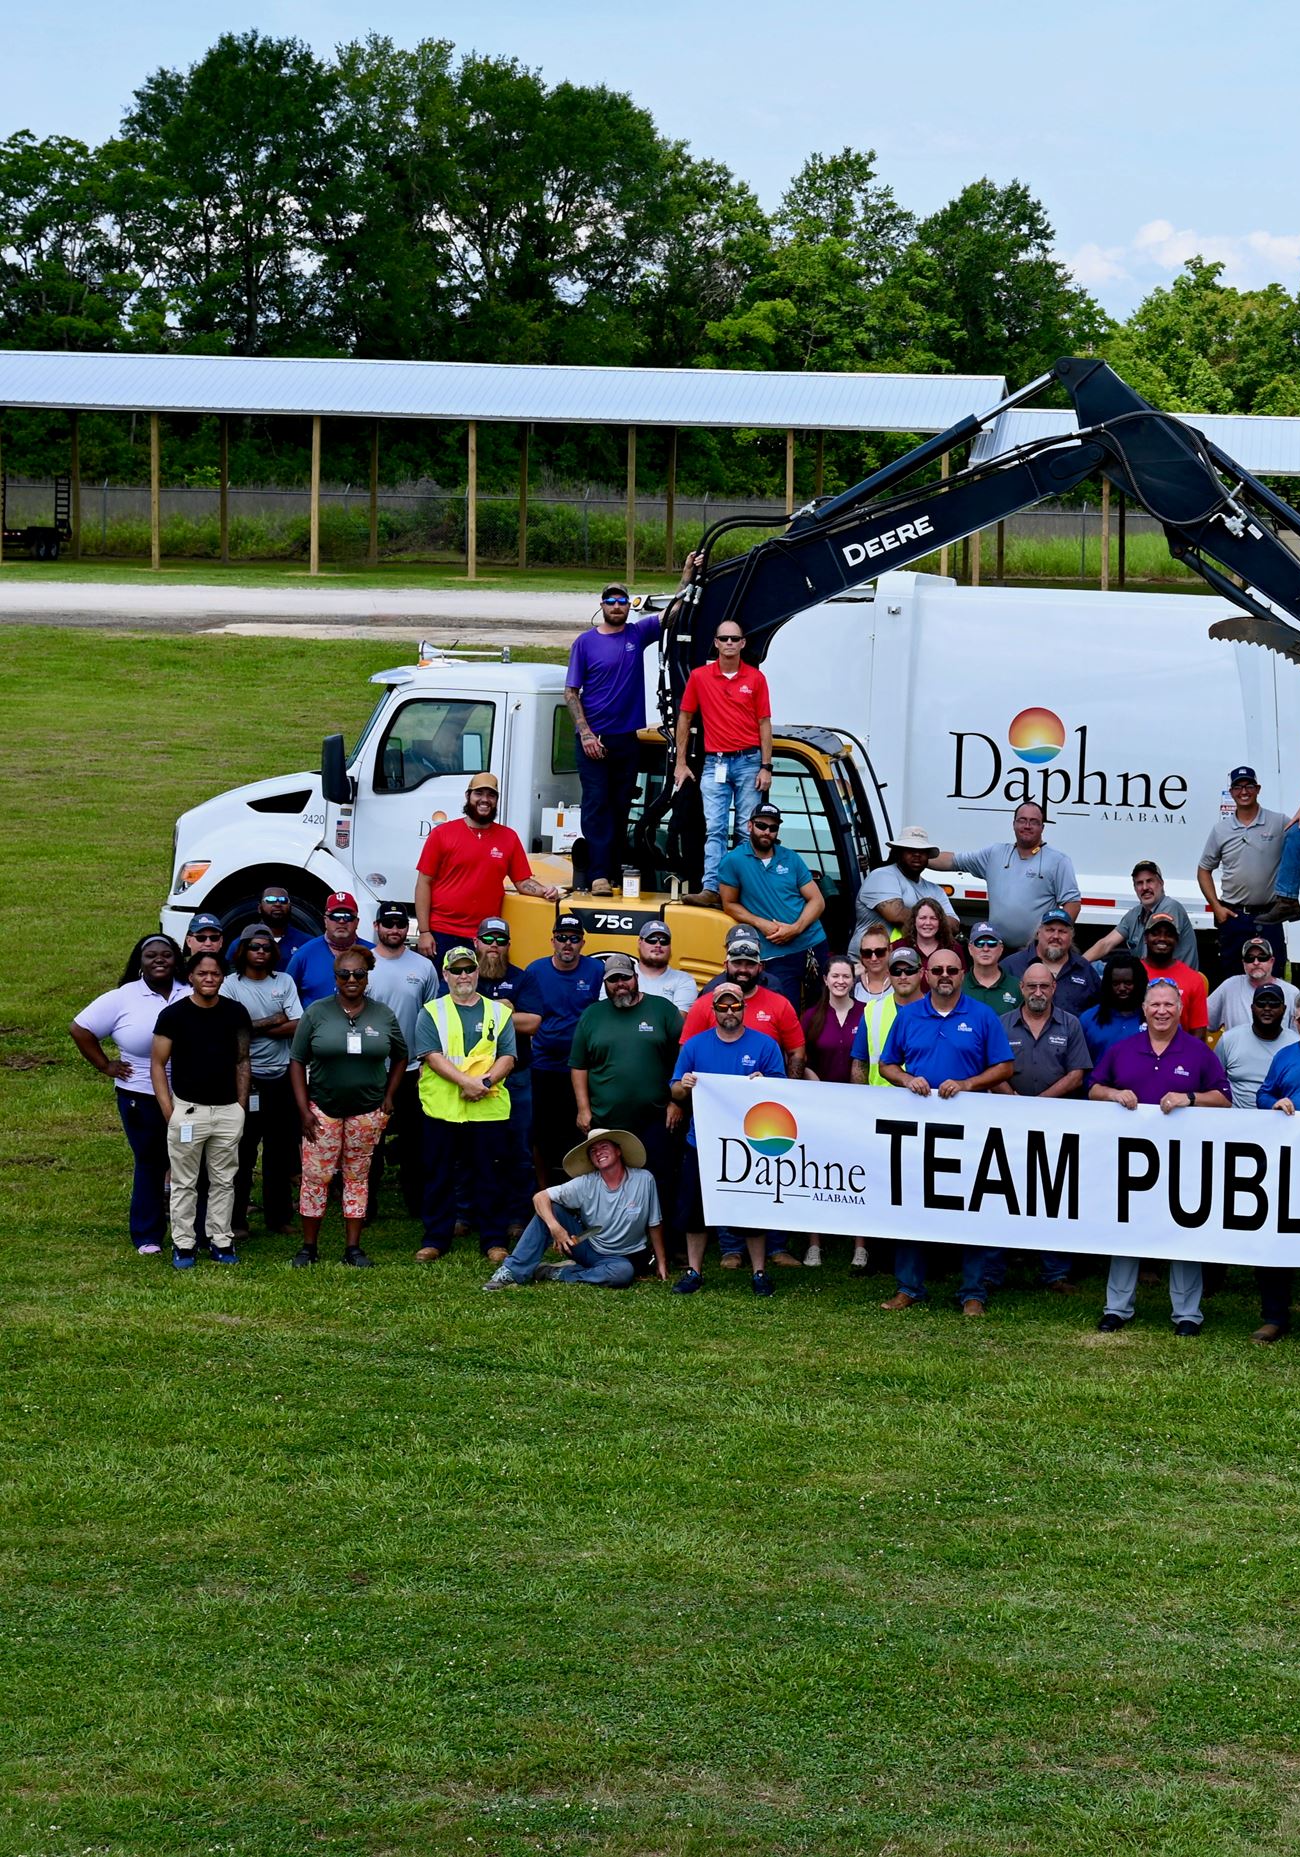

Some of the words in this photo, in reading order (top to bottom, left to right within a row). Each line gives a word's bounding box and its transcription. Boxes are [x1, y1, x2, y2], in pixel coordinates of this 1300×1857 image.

[842, 515, 935, 567] DEERE
[947, 725, 1188, 825] Daphne
[302, 813, 325, 825] 2420
[1100, 811, 1187, 824] ALABAMA
[594, 914, 633, 930] 75G
[716, 1137, 867, 1204] Daphne
[875, 1119, 1080, 1220] TEAM
[813, 1192, 866, 1205] ALABAMA
